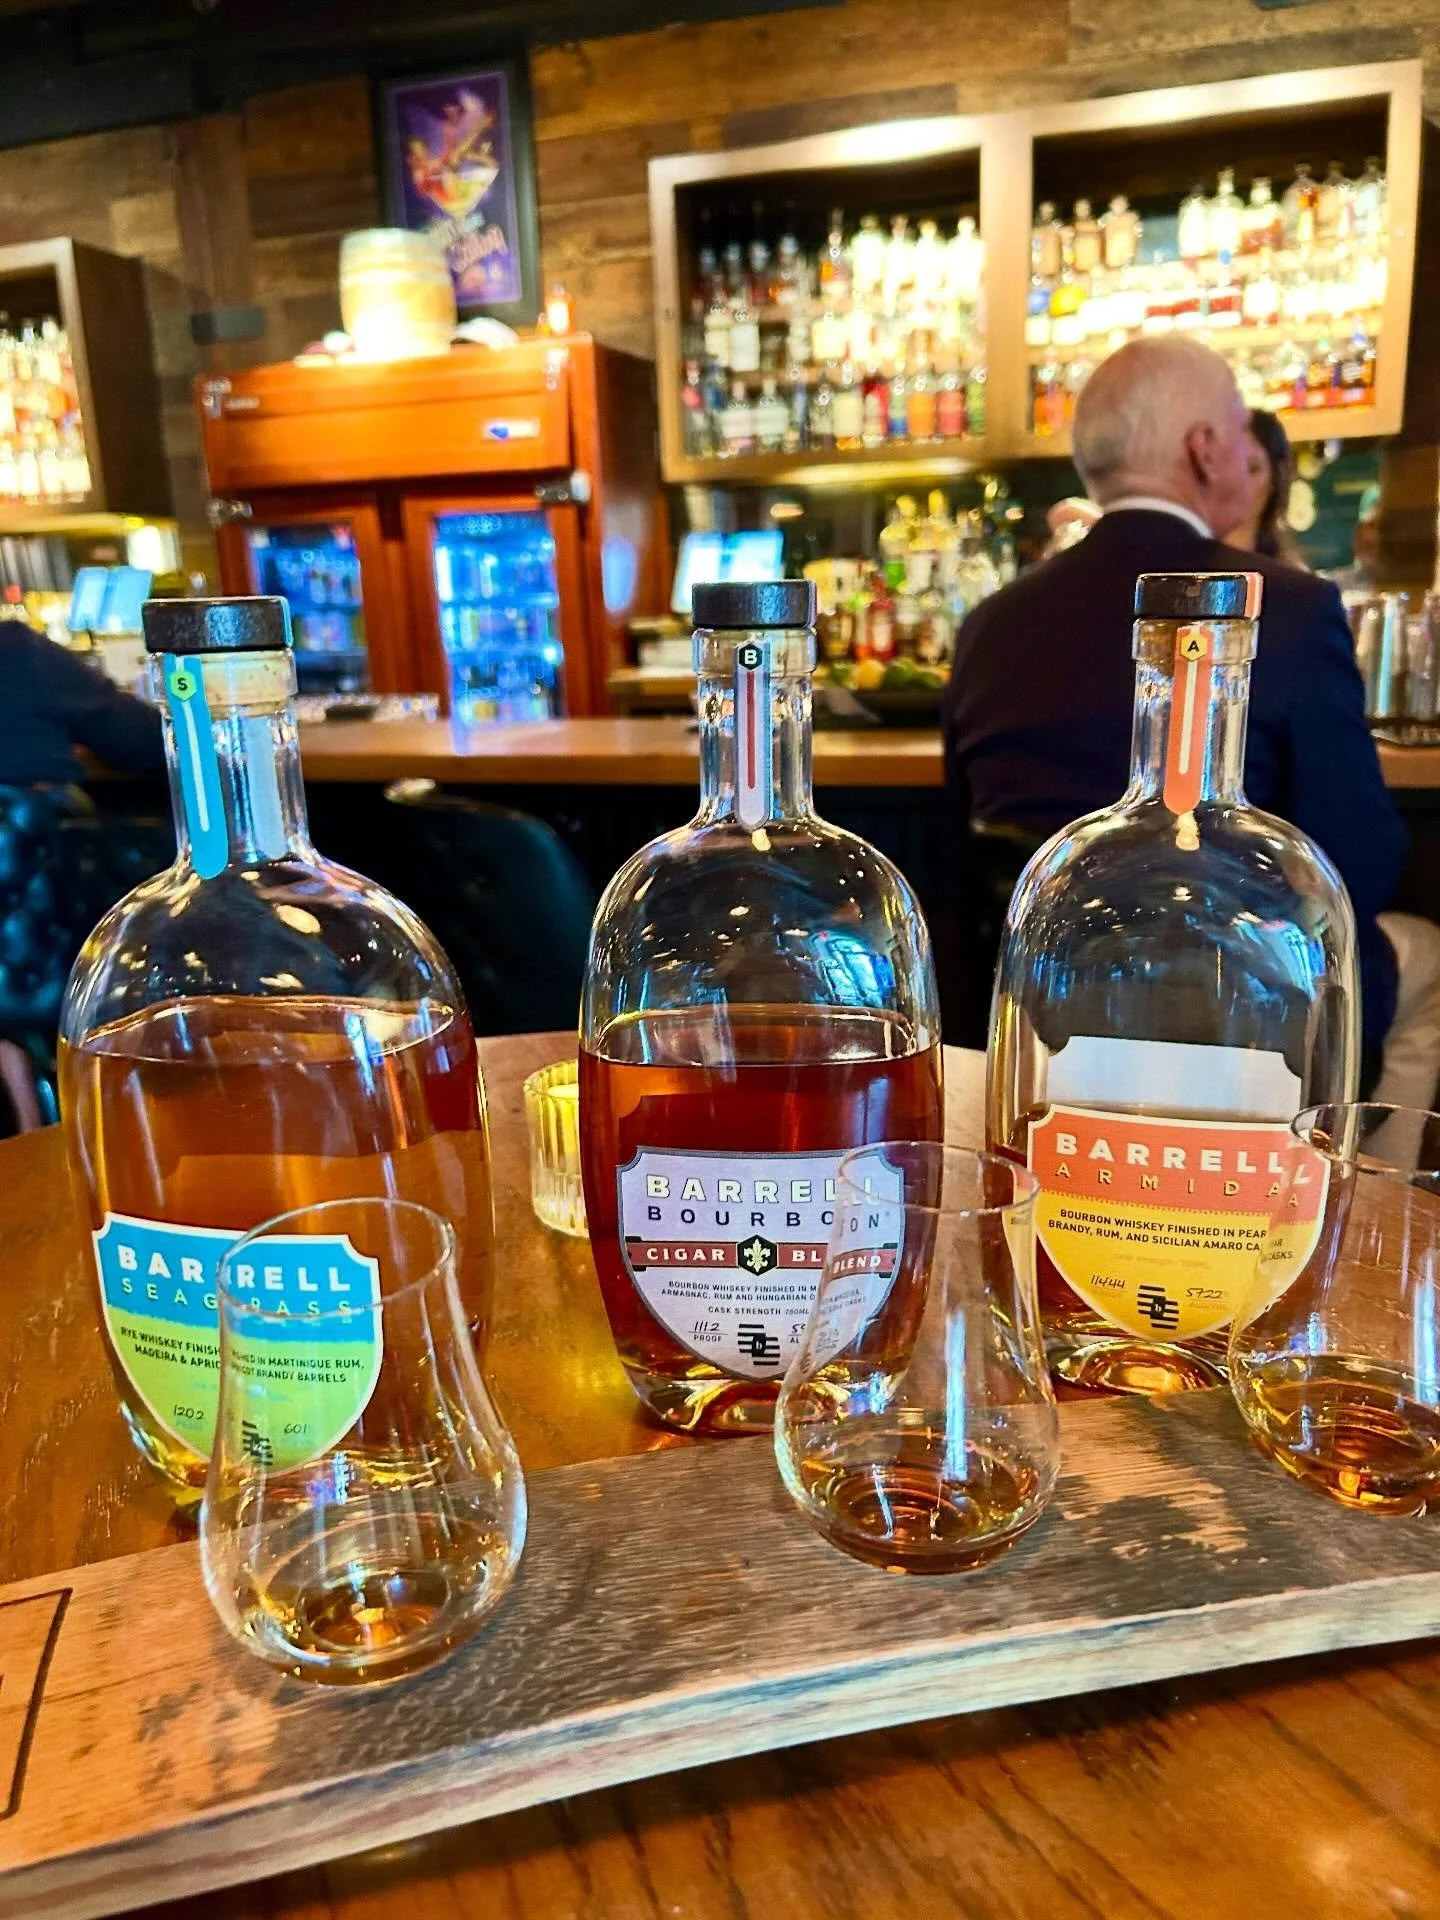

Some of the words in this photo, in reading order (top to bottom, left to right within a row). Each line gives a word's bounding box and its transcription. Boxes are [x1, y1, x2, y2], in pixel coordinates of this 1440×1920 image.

[744, 649, 758, 665] B
[1188, 640, 1200, 652] A
[177, 677, 188, 691] S
[1056, 1132, 1284, 1173] BARRELL
[646, 1174, 881, 1206] BARRELL
[1055, 1161, 1281, 1198] ARMIDA
[648, 1205, 879, 1232] BOURBON
[1060, 1209, 1111, 1225] BOURBON
[1114, 1218, 1164, 1232] WHISKEY
[1168, 1224, 1220, 1236] FINISHED
[1223, 1229, 1235, 1237] IN
[1238, 1229, 1267, 1239] PEAR
[1048, 1219, 1093, 1236] BRANDY,
[1096, 1228, 1123, 1240] RUM,
[1126, 1233, 1149, 1243] AND
[1152, 1235, 1200, 1248] SICILIAN
[1203, 1240, 1243, 1250] AMARO
[118, 1245, 351, 1292] BARRELL
[646, 1248, 725, 1261] CIGAR
[122, 1278, 352, 1316] SEAGRASS
[668, 1281, 710, 1291] BOURBON
[712, 1284, 751, 1292] WHISKEY
[755, 1285, 795, 1293] FINISHED
[735, 1293, 753, 1301] AND
[756, 1293, 807, 1301] HUNGARIAN
[708, 1306, 731, 1314] CASK
[734, 1307, 781, 1315] STRENGTH
[121, 1326, 137, 1339] RYE
[139, 1332, 183, 1350] WHISKEY
[268, 1356, 332, 1369] MARTINIQUE
[335, 1360, 364, 1369] RUM,
[693, 1334, 722, 1342] PROOF
[135, 1344, 178, 1363] MADEIRA
[256, 1368, 294, 1380] BRANDY
[297, 1372, 347, 1383] BARRELS
